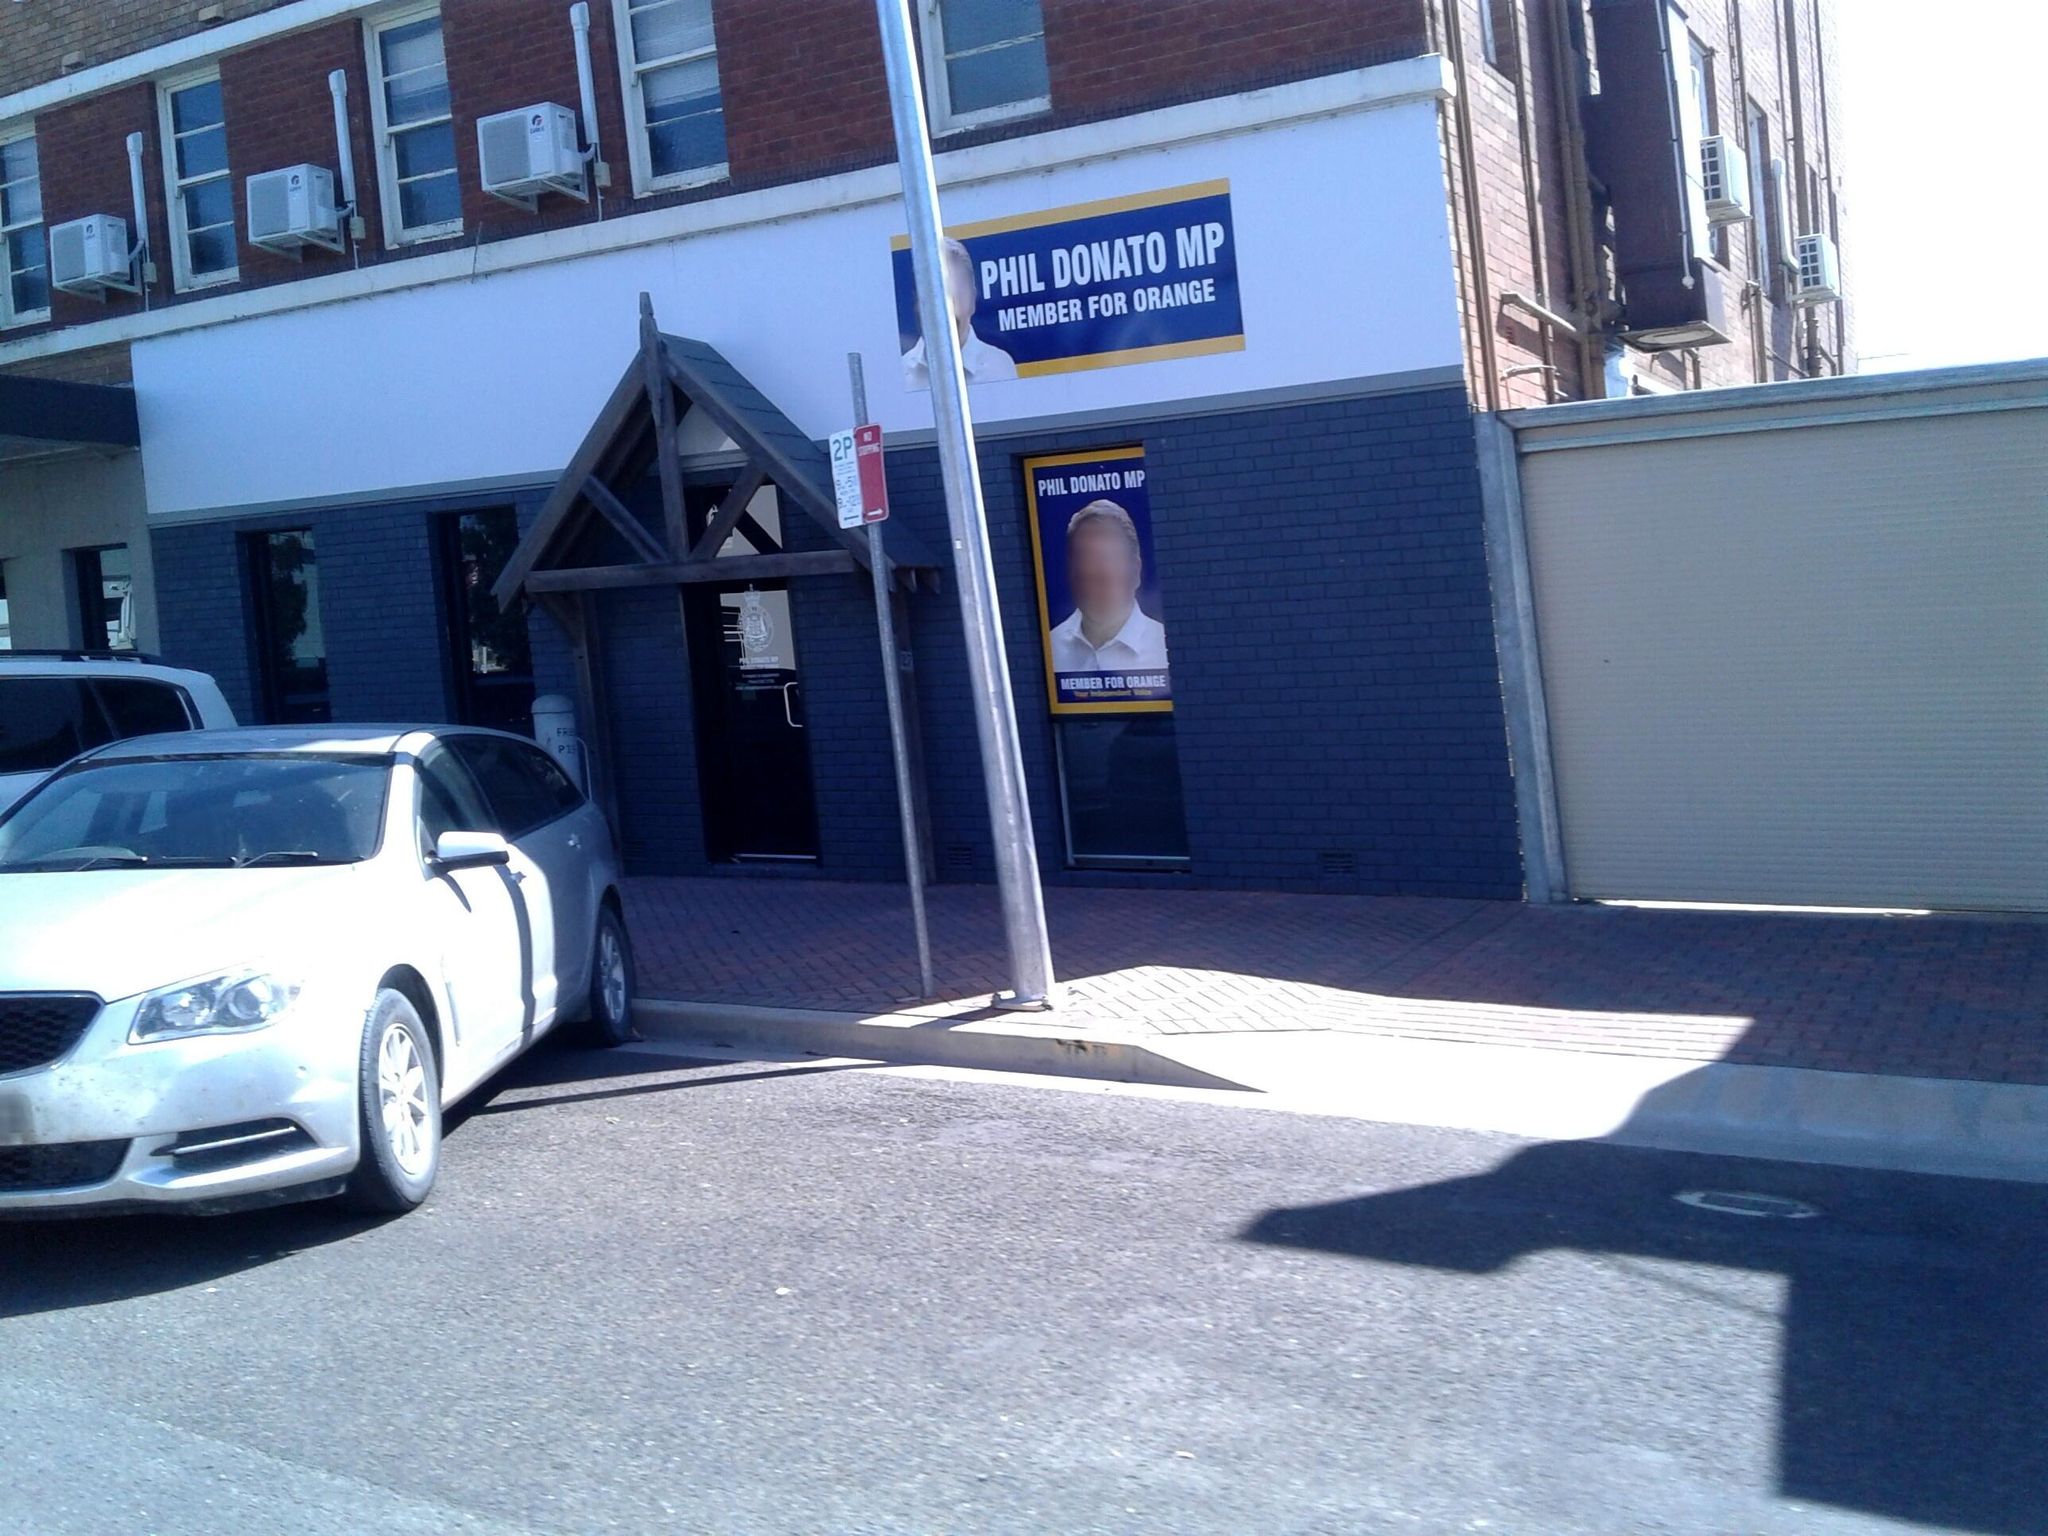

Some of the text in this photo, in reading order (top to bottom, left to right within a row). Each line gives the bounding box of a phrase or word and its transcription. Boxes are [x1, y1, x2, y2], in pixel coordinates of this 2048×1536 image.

[980, 222, 1225, 300] PHIL DONATO MP
[998, 278, 1216, 332] MEMBER FOR ORANGE
[832, 436, 852, 461] 2P
[1038, 470, 1146, 497] PHIL DONATO MP
[1060, 675, 1167, 690] MEMBER FOR ORANGE
